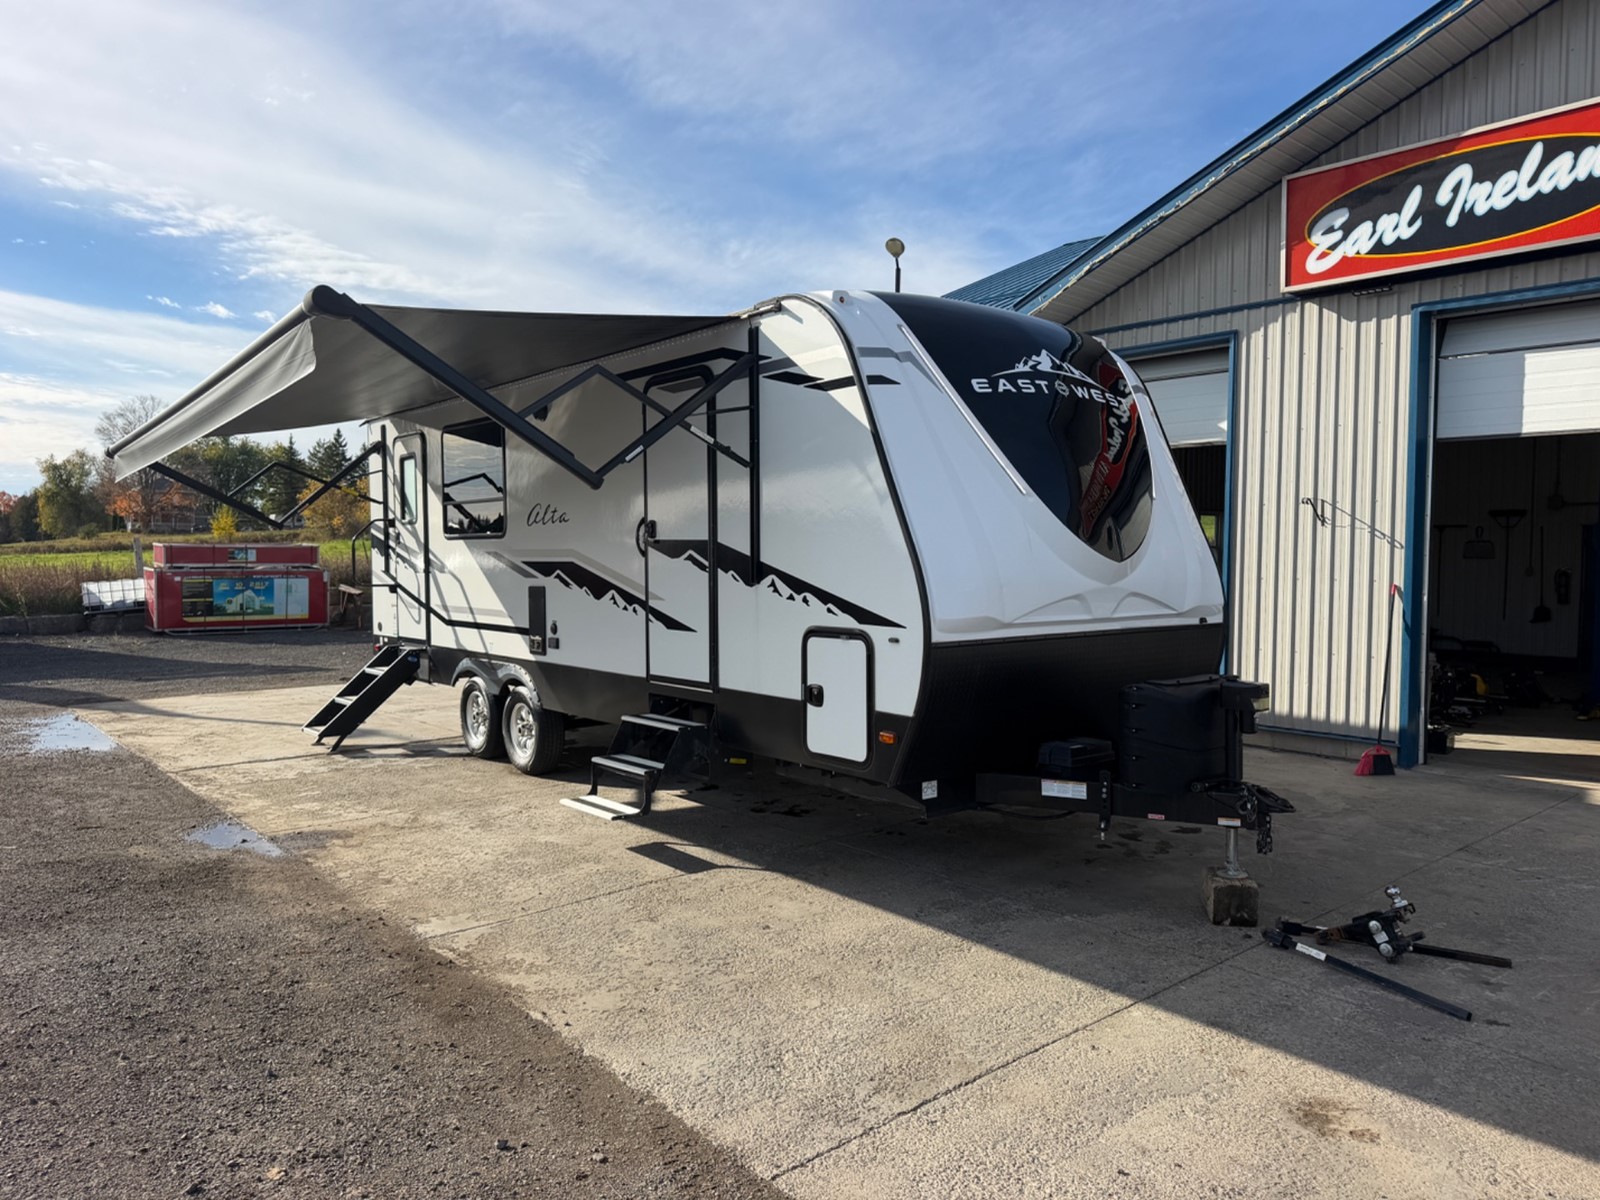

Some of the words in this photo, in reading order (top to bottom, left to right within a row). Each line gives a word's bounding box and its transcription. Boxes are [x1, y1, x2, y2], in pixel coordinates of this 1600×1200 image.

[1305, 184, 1423, 274] Earl
[971, 378, 1049, 394] EAST
[1070, 384, 1130, 414] WEST
[527, 502, 570, 527] Alta
